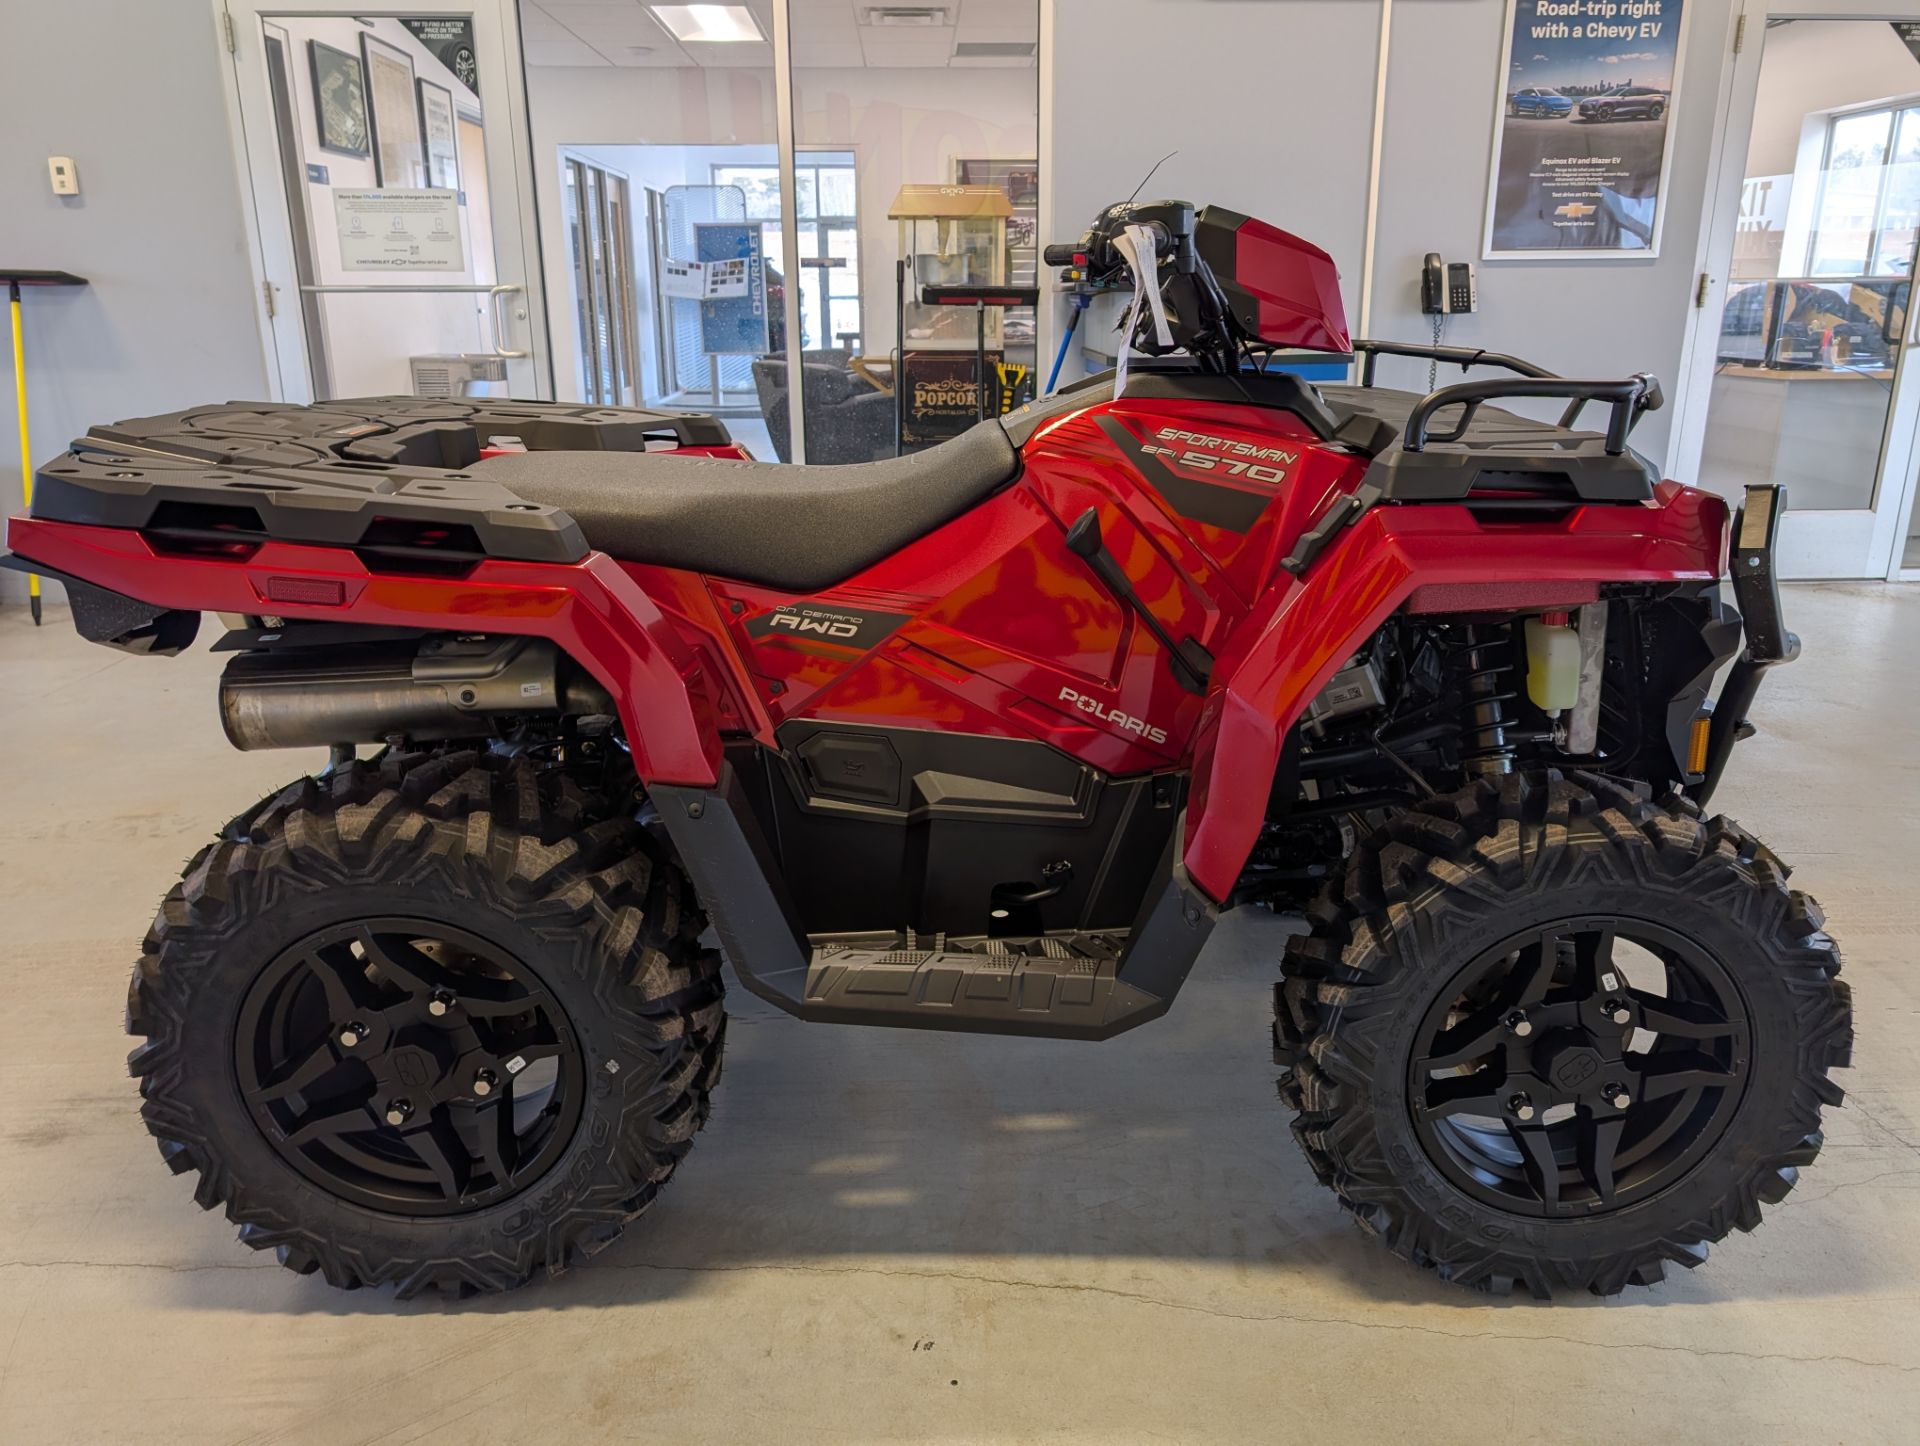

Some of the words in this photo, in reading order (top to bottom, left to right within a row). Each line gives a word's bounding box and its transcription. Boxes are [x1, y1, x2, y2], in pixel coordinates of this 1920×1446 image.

[1536, 0, 1617, 18] Road-trip
[1620, 0, 1661, 18] right
[1531, 22, 1568, 38] with
[1572, 25, 1582, 38] a
[1586, 22, 1637, 40] Chevy
[1640, 22, 1662, 38] EV
[749, 229, 762, 315] CHEVROLET
[1156, 427, 1298, 464] SPORTSMAN
[1140, 444, 1177, 458] EFI
[1178, 451, 1287, 484] 570
[769, 613, 858, 638] AWD
[775, 605, 797, 614] ON
[802, 609, 863, 624] DEMAND
[1058, 686, 1168, 744] POLARIS
